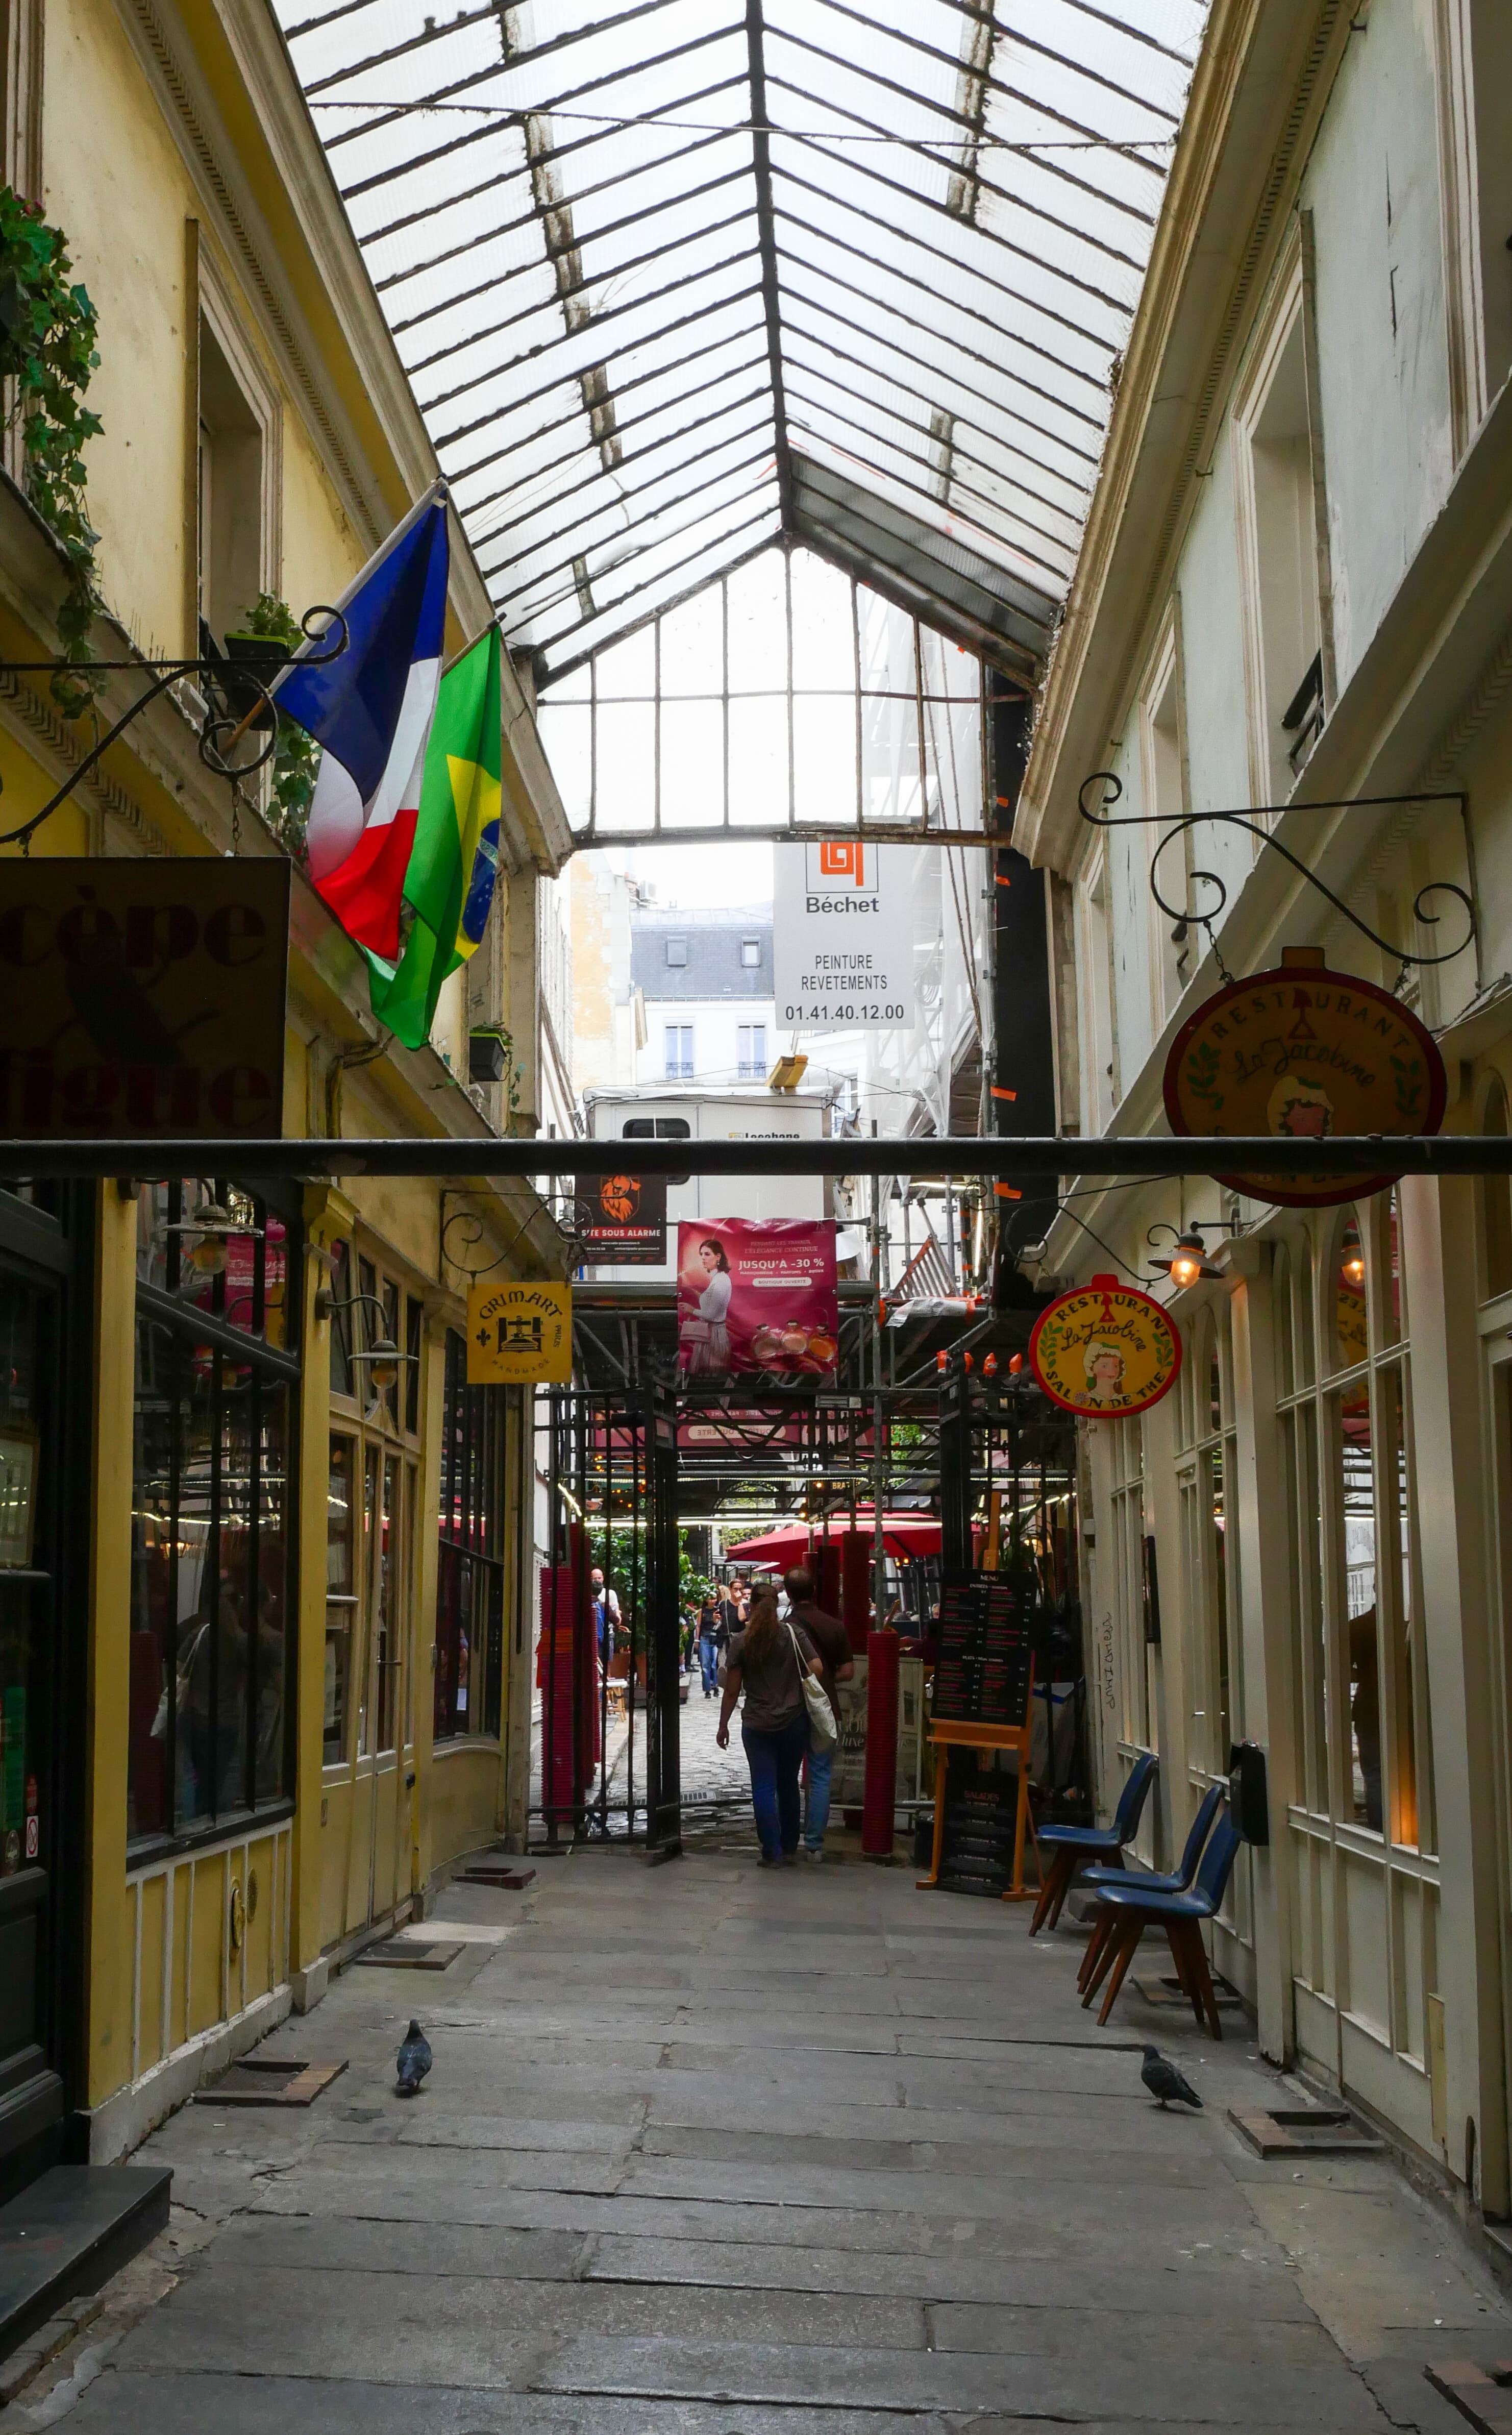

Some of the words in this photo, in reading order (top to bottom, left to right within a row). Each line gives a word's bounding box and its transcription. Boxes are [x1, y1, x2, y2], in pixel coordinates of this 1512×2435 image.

[806, 896, 880, 914] Béchet
[815, 954, 873, 970] PEINTURE
[801, 975, 887, 991] REVETEMENTS
[785, 1004, 904, 1021] 01.41.40.12.00
[479, 1290, 563, 1319] GRIMART
[1061, 1327, 1082, 1351] La
[1080, 1320, 1147, 1352] Jacobine
[1110, 1395, 1132, 1409] DE
